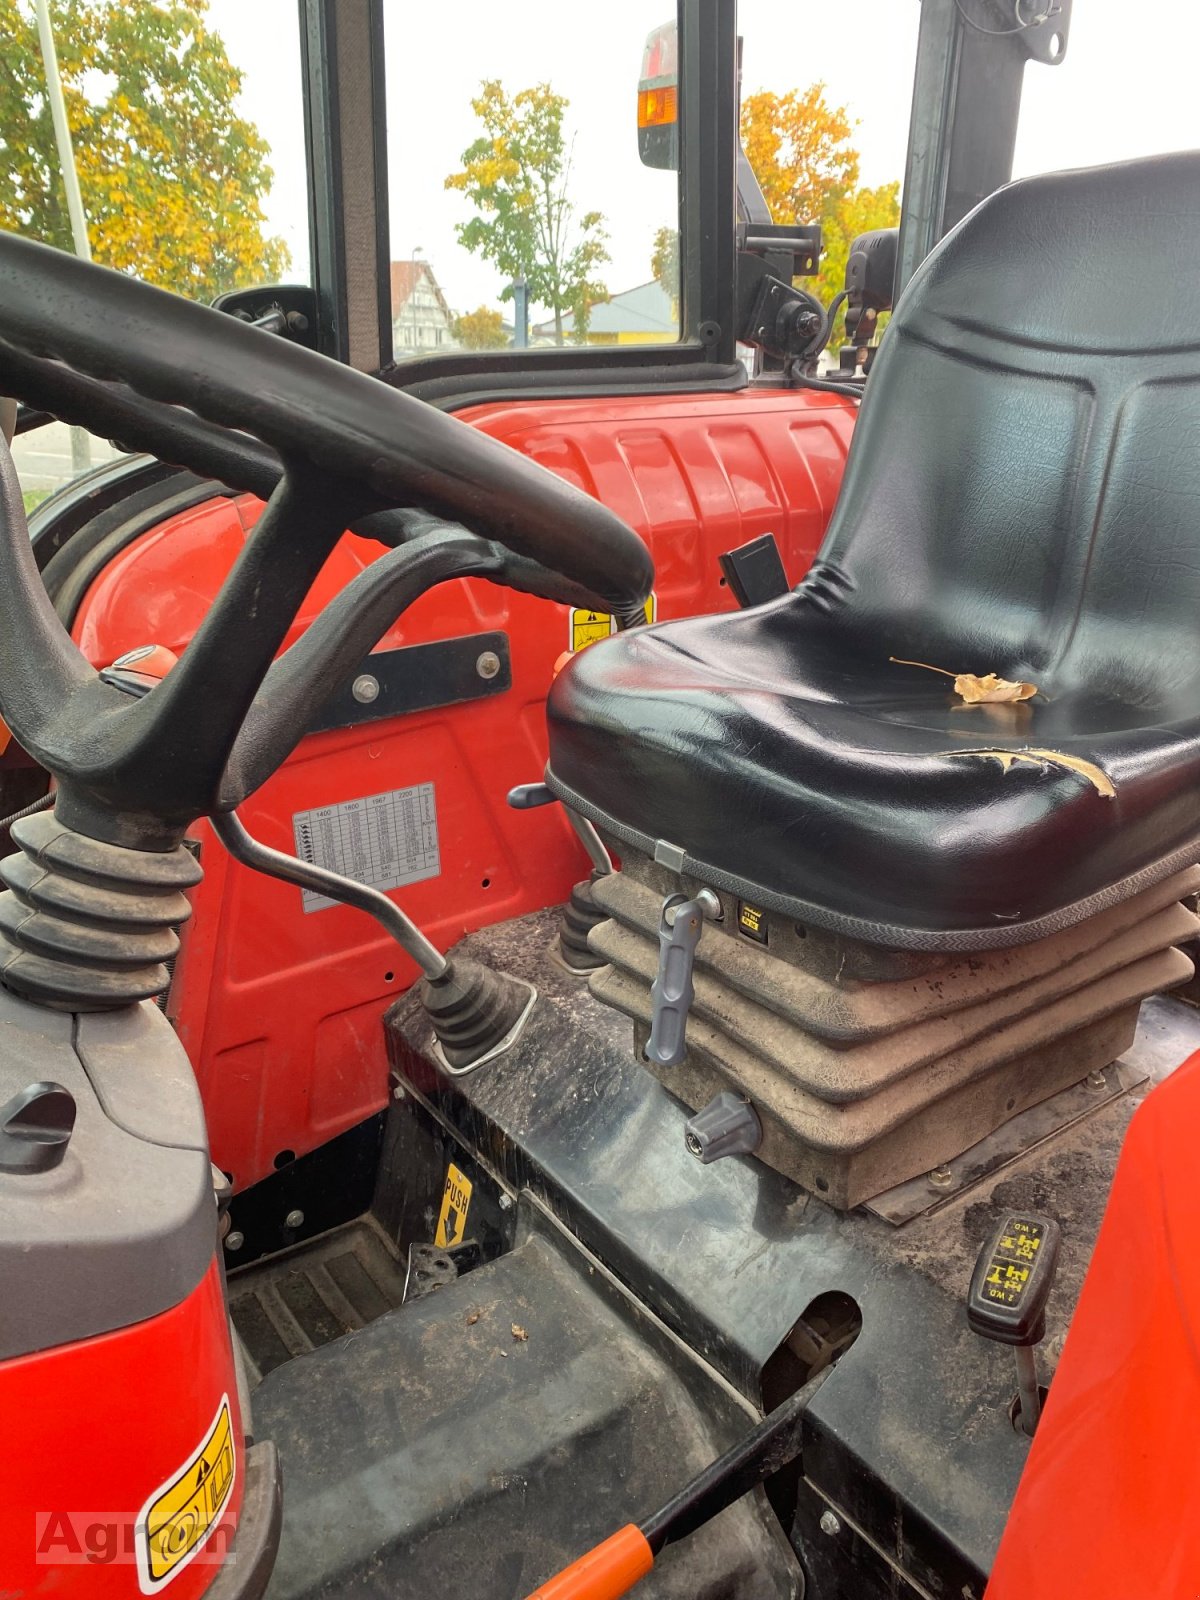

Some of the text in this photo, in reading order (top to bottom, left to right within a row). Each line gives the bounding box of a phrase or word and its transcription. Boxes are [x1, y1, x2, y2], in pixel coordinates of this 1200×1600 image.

[316, 810, 332, 818] 1400
[344, 803, 360, 811] 1800
[398, 790, 413, 799] 2200
[445, 1177, 468, 1215] PUSH
[1008, 1294, 1015, 1302] 2
